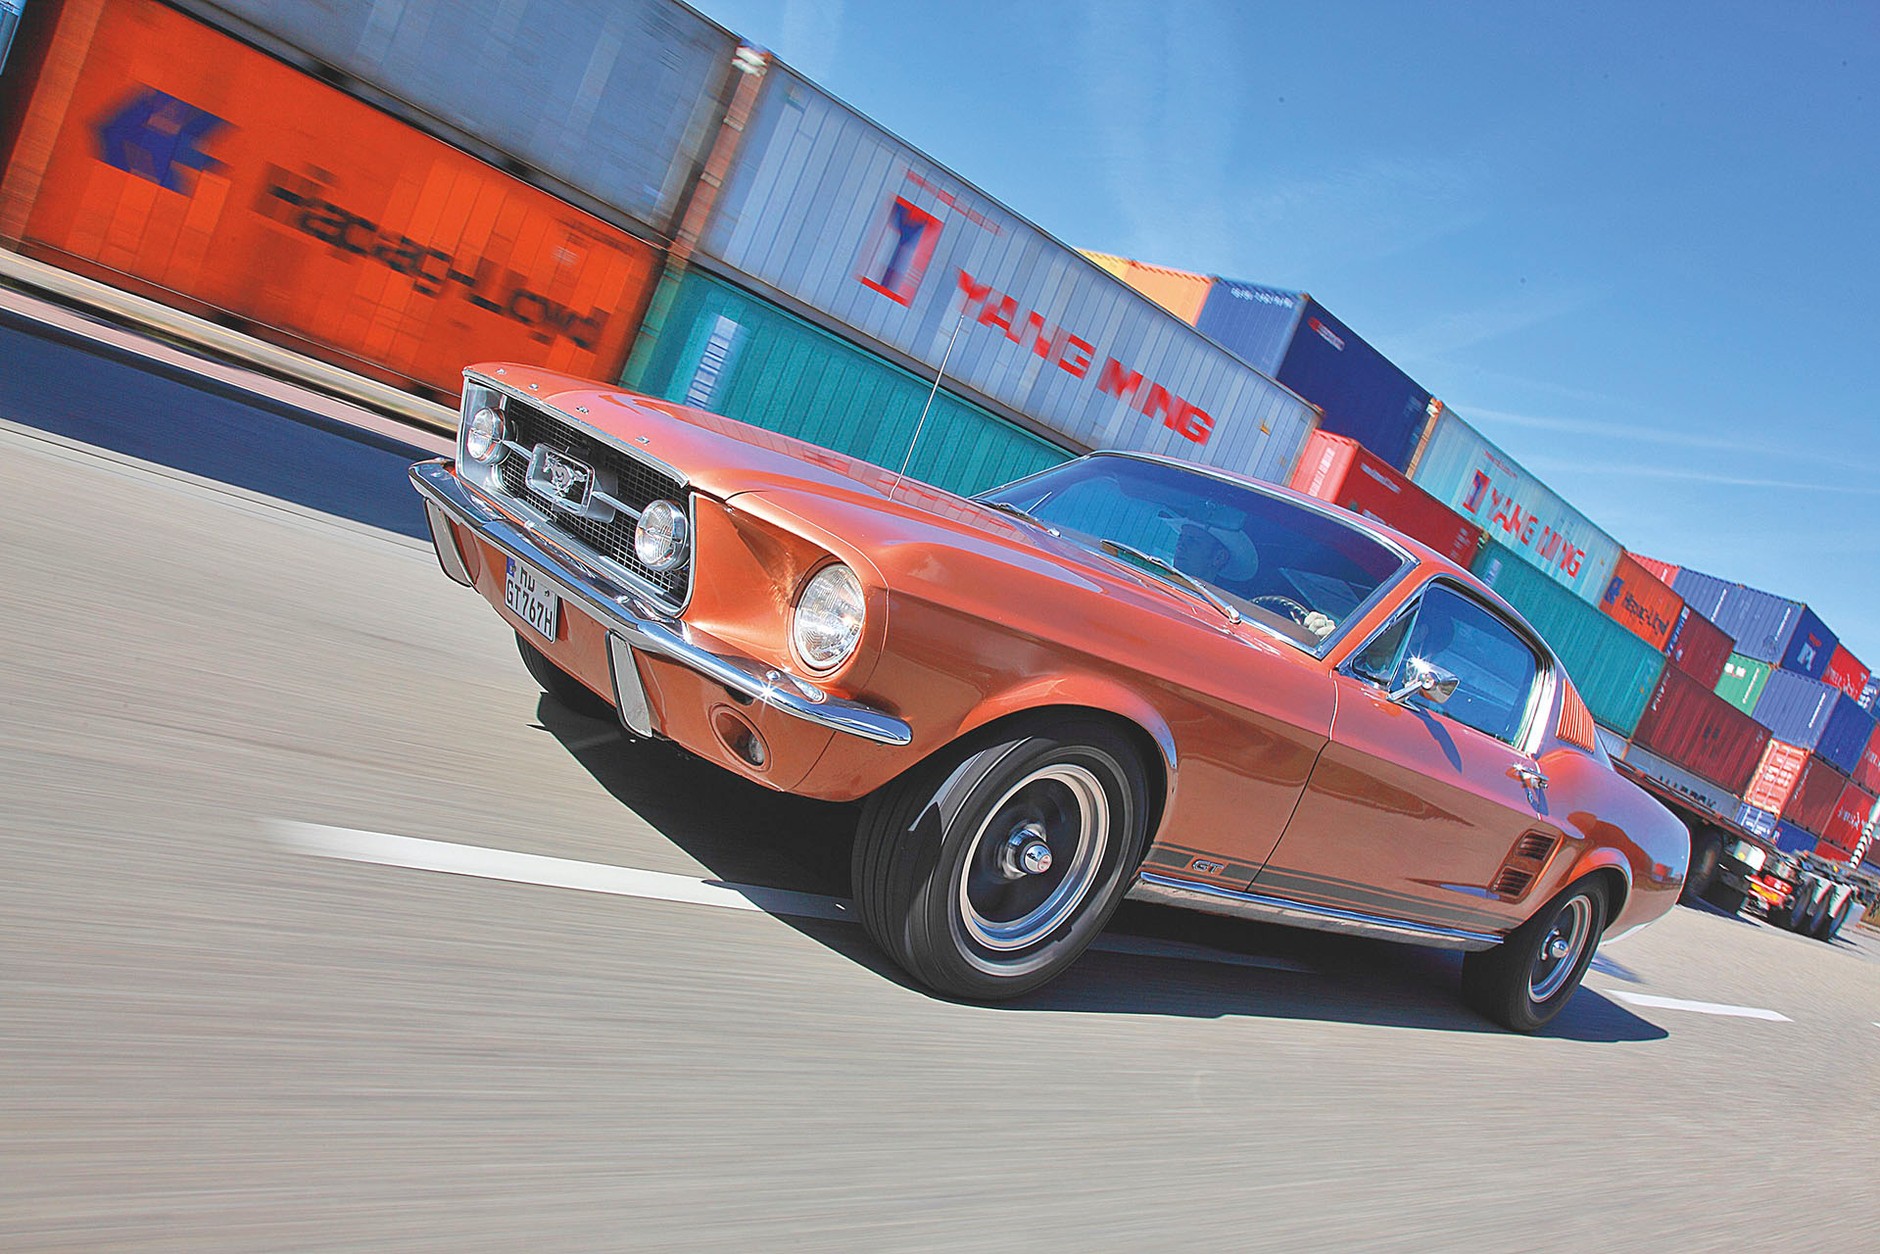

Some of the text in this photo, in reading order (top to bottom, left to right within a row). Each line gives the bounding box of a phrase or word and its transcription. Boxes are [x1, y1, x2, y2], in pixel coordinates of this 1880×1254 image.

[957, 267, 1215, 446] YANG MING
[1192, 860, 1224, 874] GT
